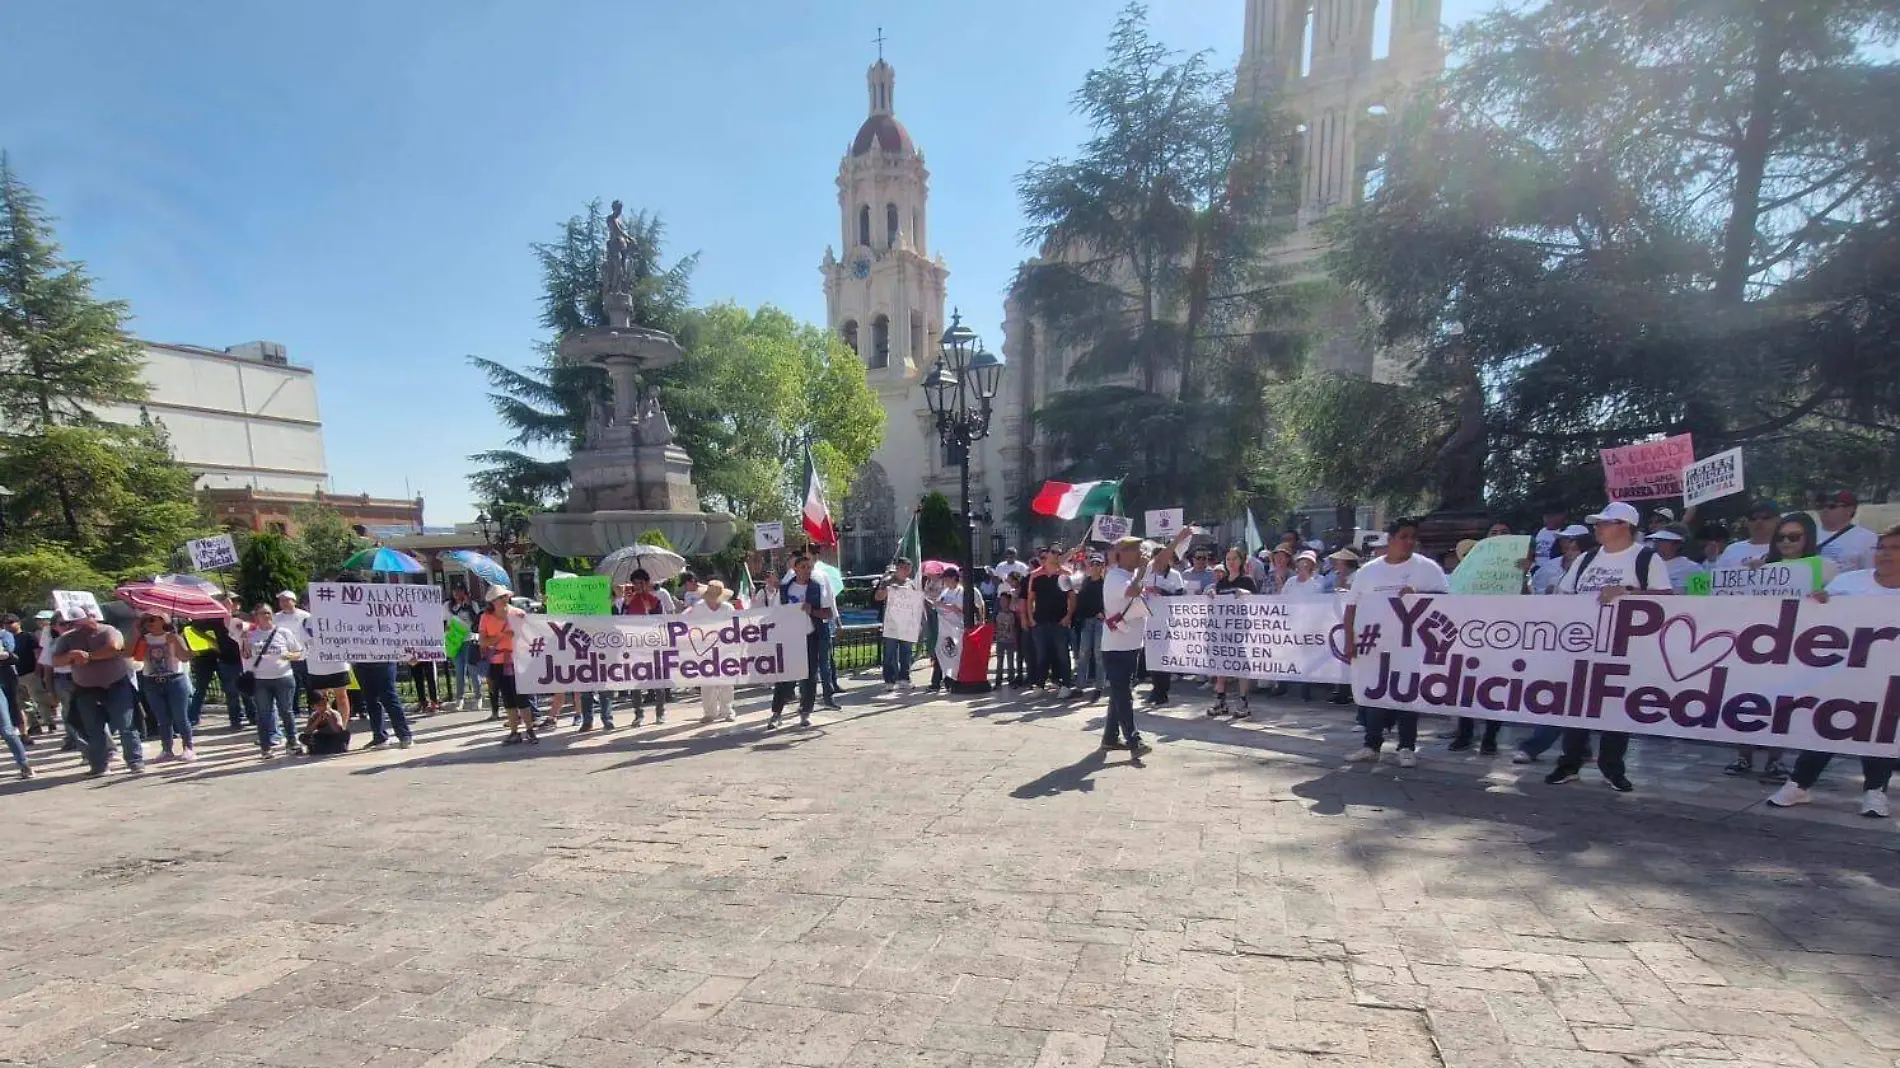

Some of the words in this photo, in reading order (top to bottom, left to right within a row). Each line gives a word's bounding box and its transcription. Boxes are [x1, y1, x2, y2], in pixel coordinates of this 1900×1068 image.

[1713, 566, 1790, 588] LIBERTAD
[342, 585, 363, 602] NO
[366, 603, 418, 617] JUDICIAL
[1168, 604, 1215, 615] TERCER
[1218, 604, 1289, 617] TRIBUNAL
[1168, 618, 1222, 629] LABORAL
[1225, 619, 1292, 631] FEDERAL
[1146, 630, 1161, 641] DE
[1164, 631, 1218, 643] ASUNTOS
[1221, 633, 1325, 646] INDIVIDUALES
[1186, 644, 1209, 655] CON
[1212, 646, 1246, 658] SEDE
[1252, 648, 1273, 658] EN
